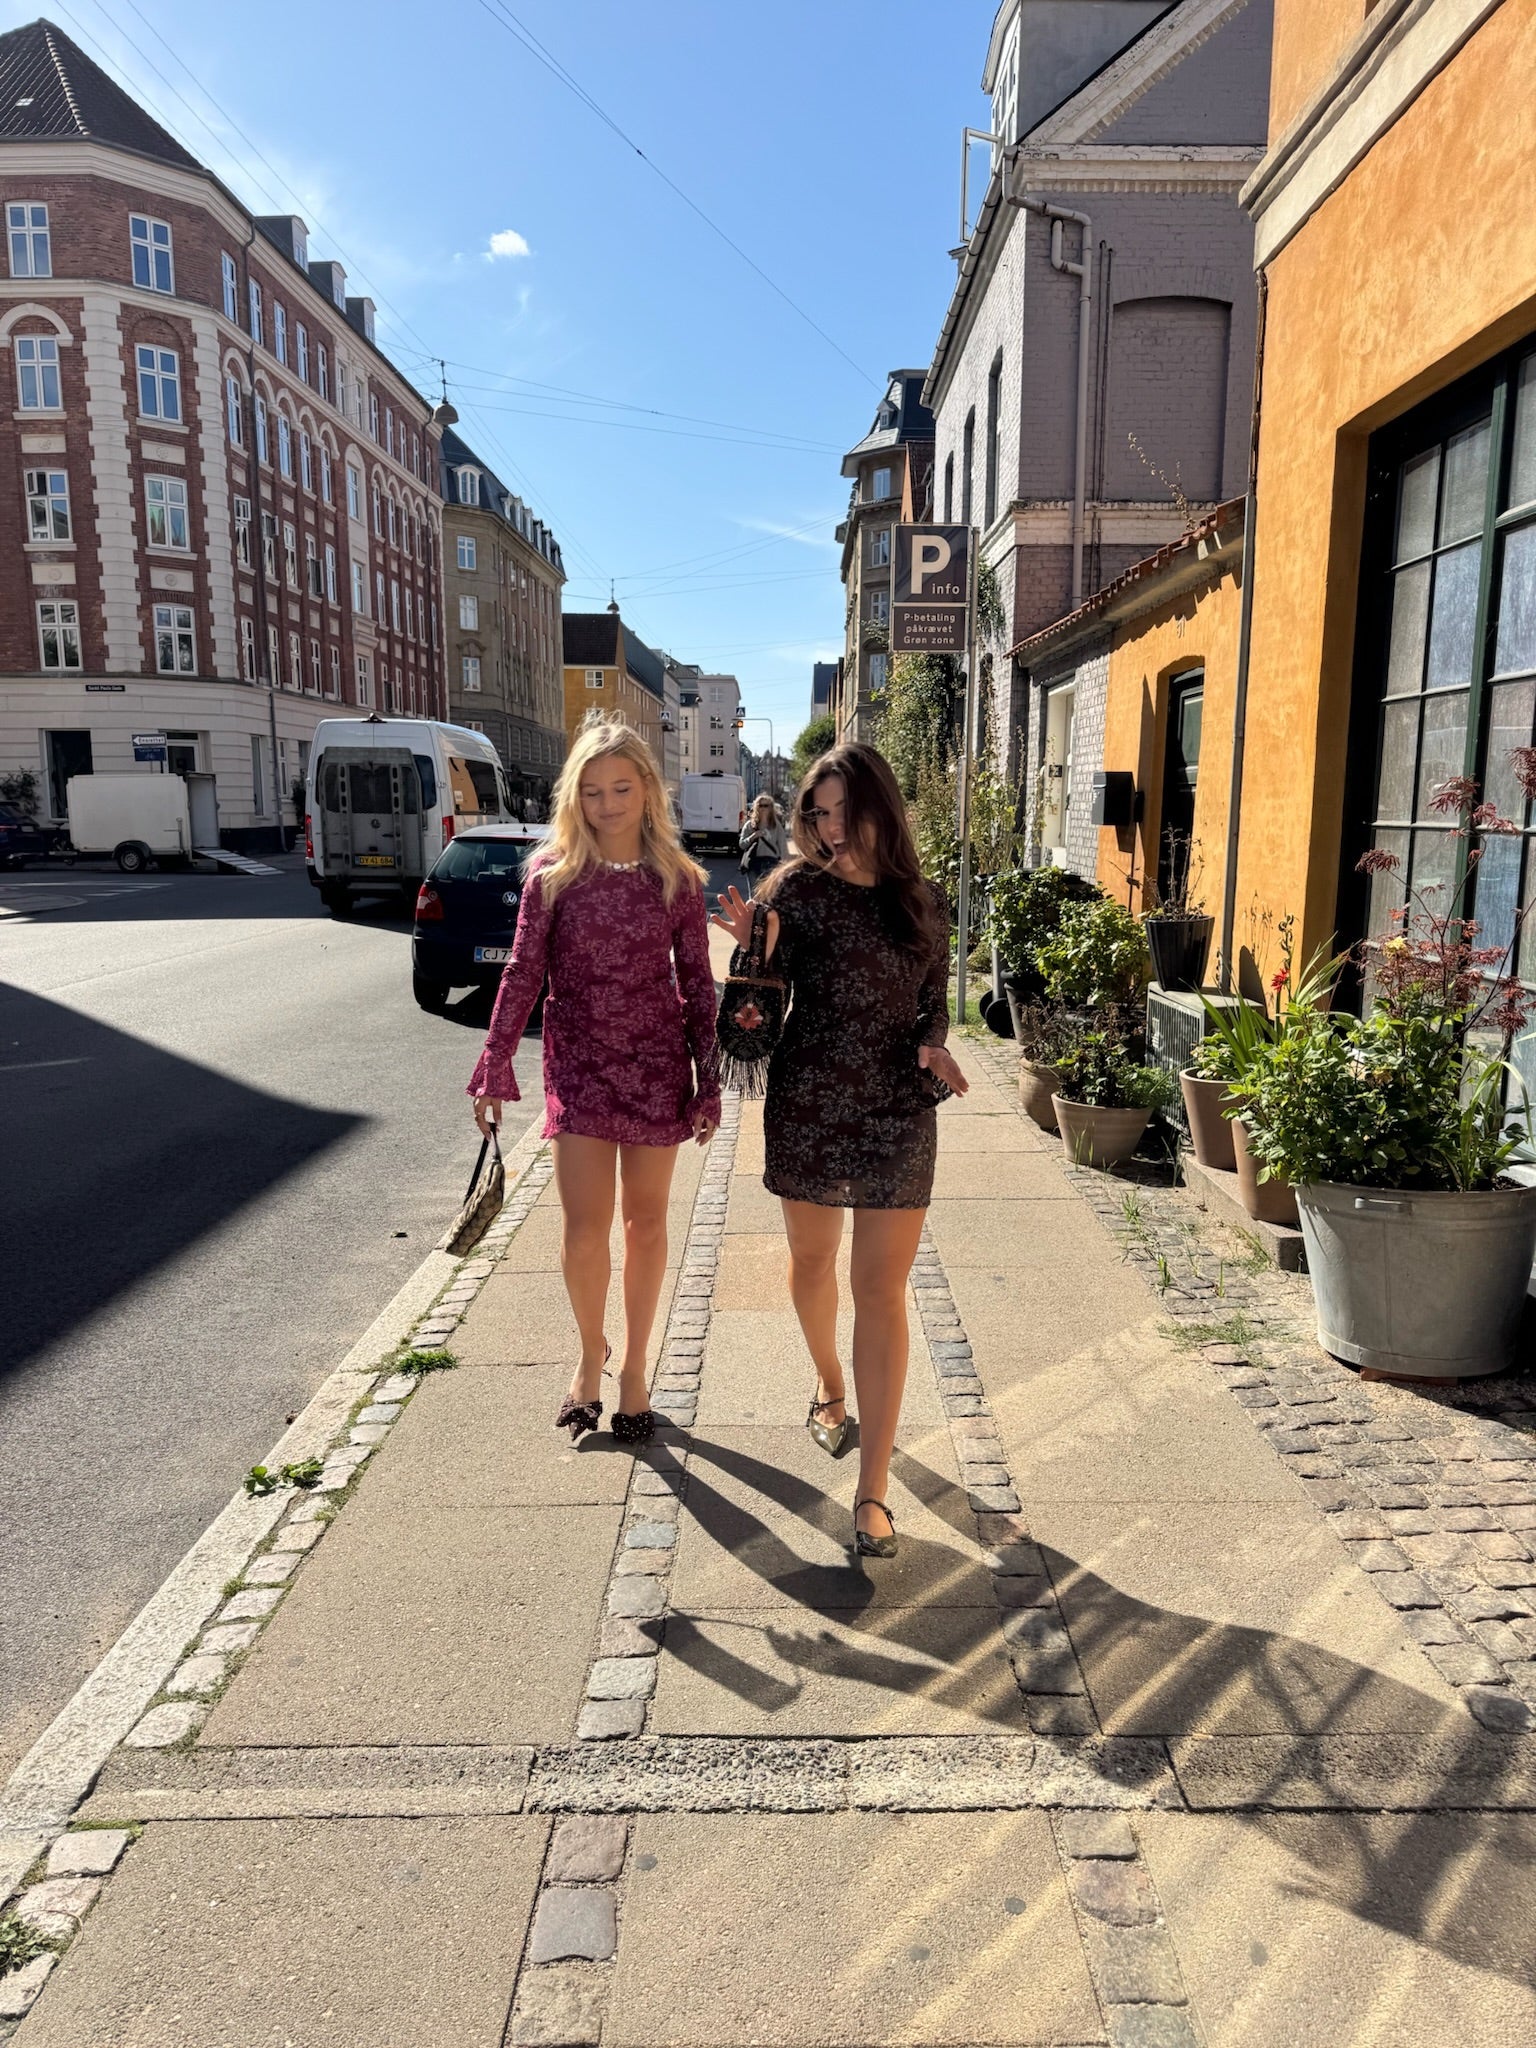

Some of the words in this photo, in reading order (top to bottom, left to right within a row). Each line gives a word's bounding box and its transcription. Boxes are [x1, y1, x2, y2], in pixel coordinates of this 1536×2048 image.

[910, 534, 952, 594] P
[932, 583, 960, 595] info
[903, 613, 956, 623] P-betaling
[905, 624, 953, 634] påkrævet
[483, 949, 498, 960] CJ
